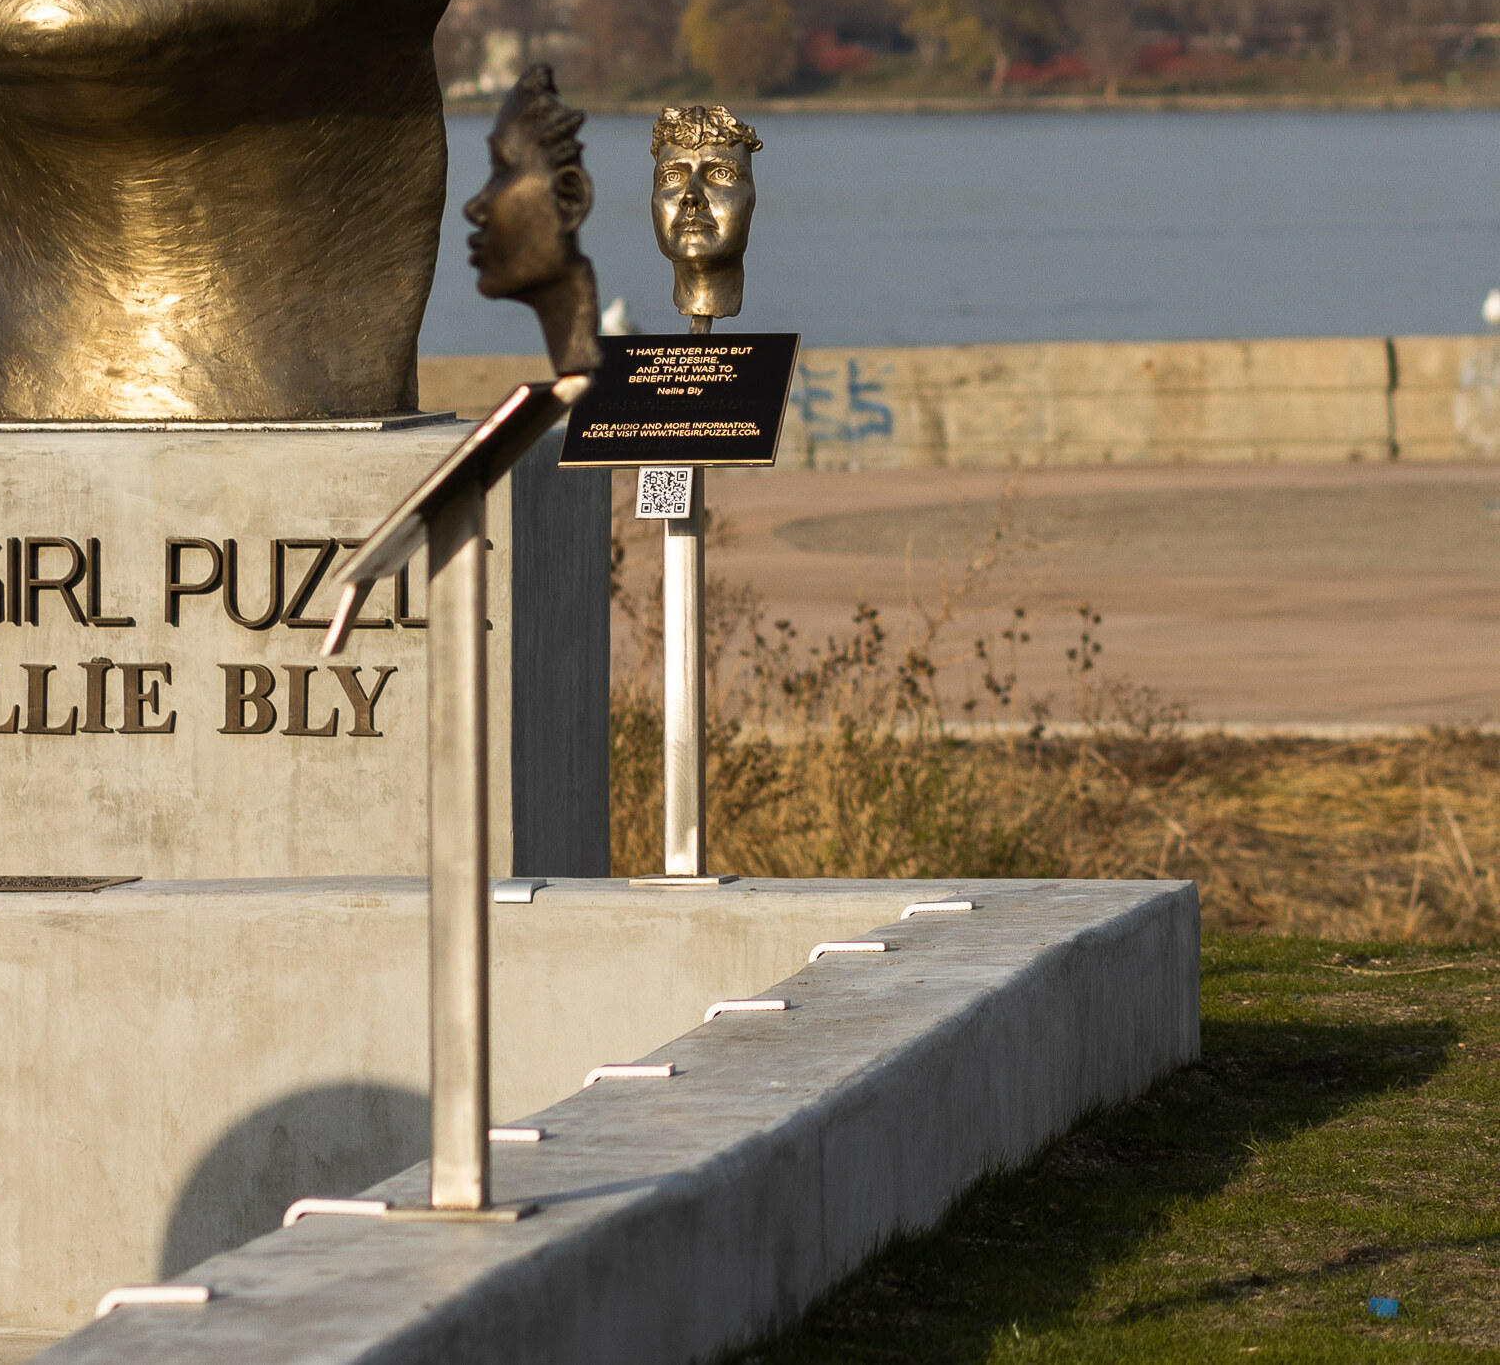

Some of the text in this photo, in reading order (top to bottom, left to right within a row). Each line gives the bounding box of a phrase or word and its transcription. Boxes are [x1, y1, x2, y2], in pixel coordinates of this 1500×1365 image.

[636, 348, 664, 356] HAVE
[704, 347, 728, 355] HAD
[730, 347, 753, 355] BUT
[653, 357, 676, 365] ONE
[636, 366, 660, 374] AND
[691, 365, 716, 373] WAS
[718, 365, 733, 373] TO
[628, 375, 672, 383] BENEFIT
[657, 387, 703, 396] Nellie Bly
[590, 423, 609, 431] FOR
[641, 422, 662, 430] AND
[663, 422, 690, 430] MORE
[582, 430, 615, 438] PLEASE
[640, 428, 760, 437] WWW.THEGIRLPUZZLE.COM
[164, 536, 493, 632] PUZZL
[216, 662, 398, 737] BLY
